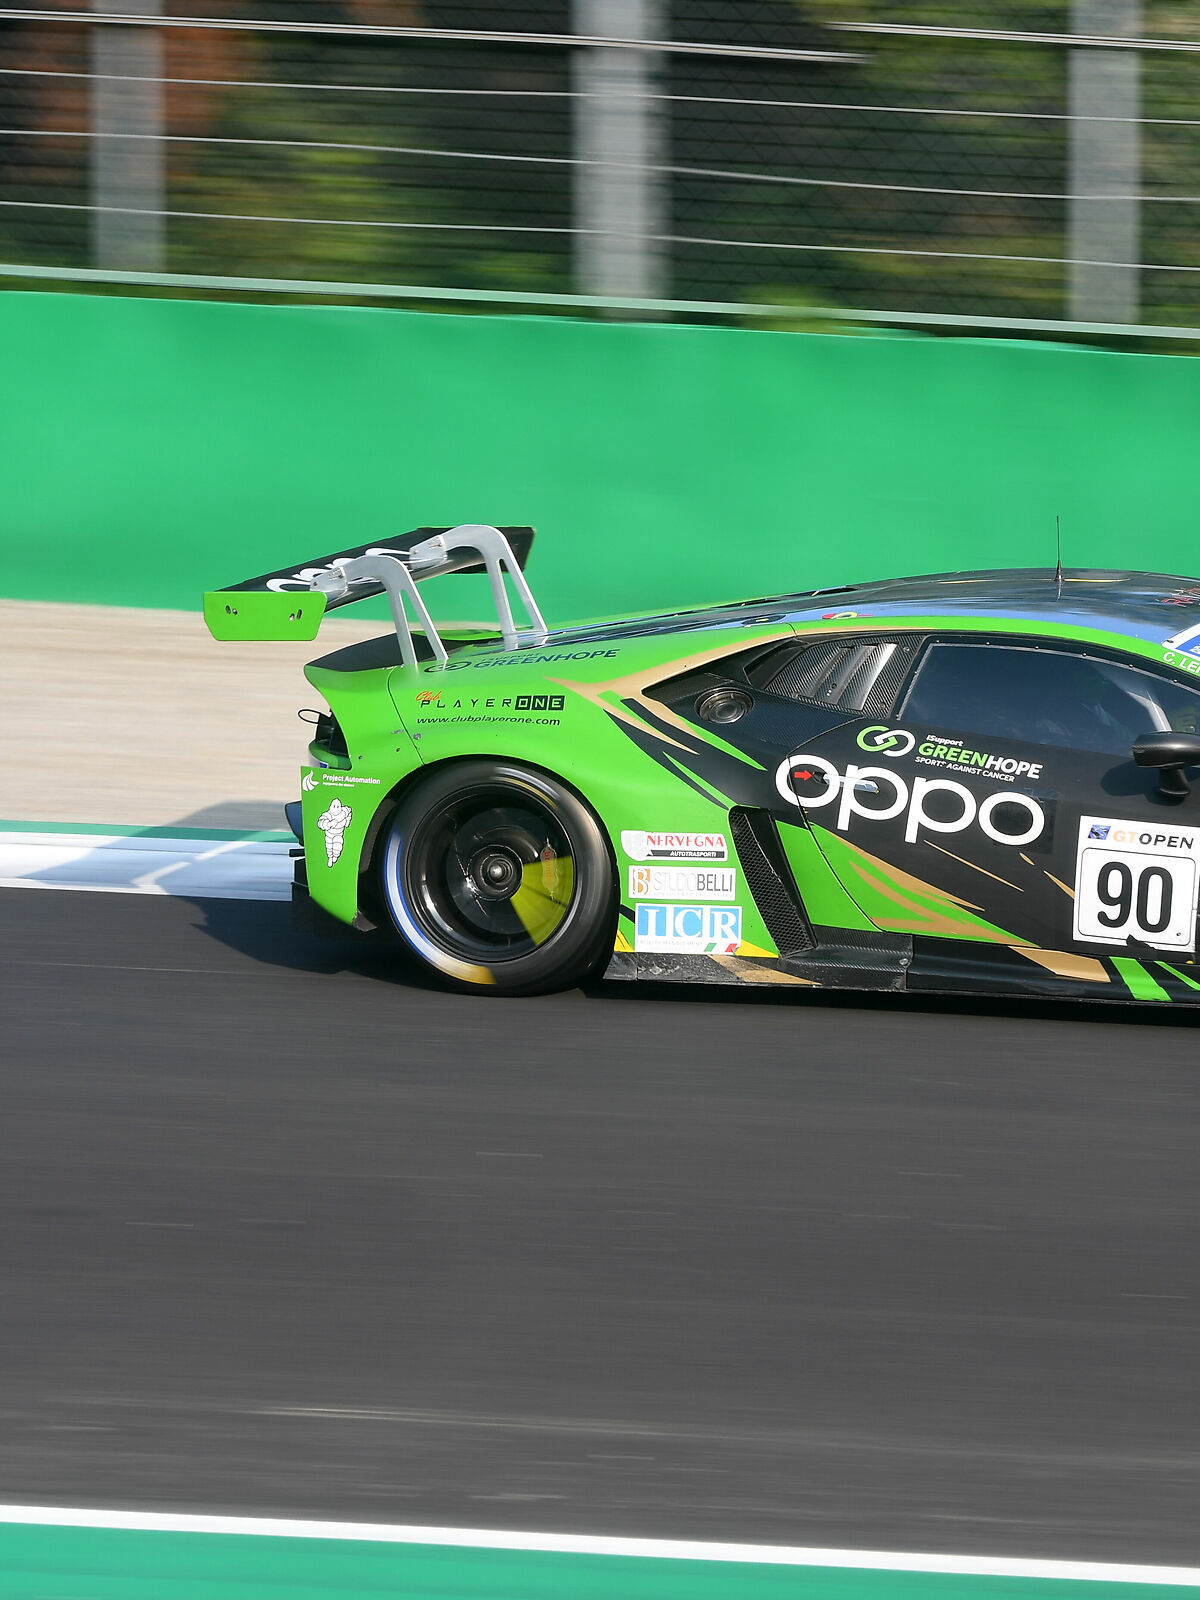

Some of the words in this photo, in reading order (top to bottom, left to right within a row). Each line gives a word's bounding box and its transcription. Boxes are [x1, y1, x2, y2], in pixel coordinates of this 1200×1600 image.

[1162, 652, 1176, 664] C.
[416, 714, 561, 726] www.clubplayerone.com
[322, 773, 344, 783] Project
[344, 775, 381, 785] Automation
[946, 762, 982, 776] AGAINST
[982, 769, 1016, 783] CANCER
[774, 753, 1045, 846] oppo
[646, 834, 725, 847] NERVEGNA
[669, 850, 717, 858] AUTOTRASPORTI
[1097, 861, 1174, 933] 90
[640, 906, 739, 939] ICR
